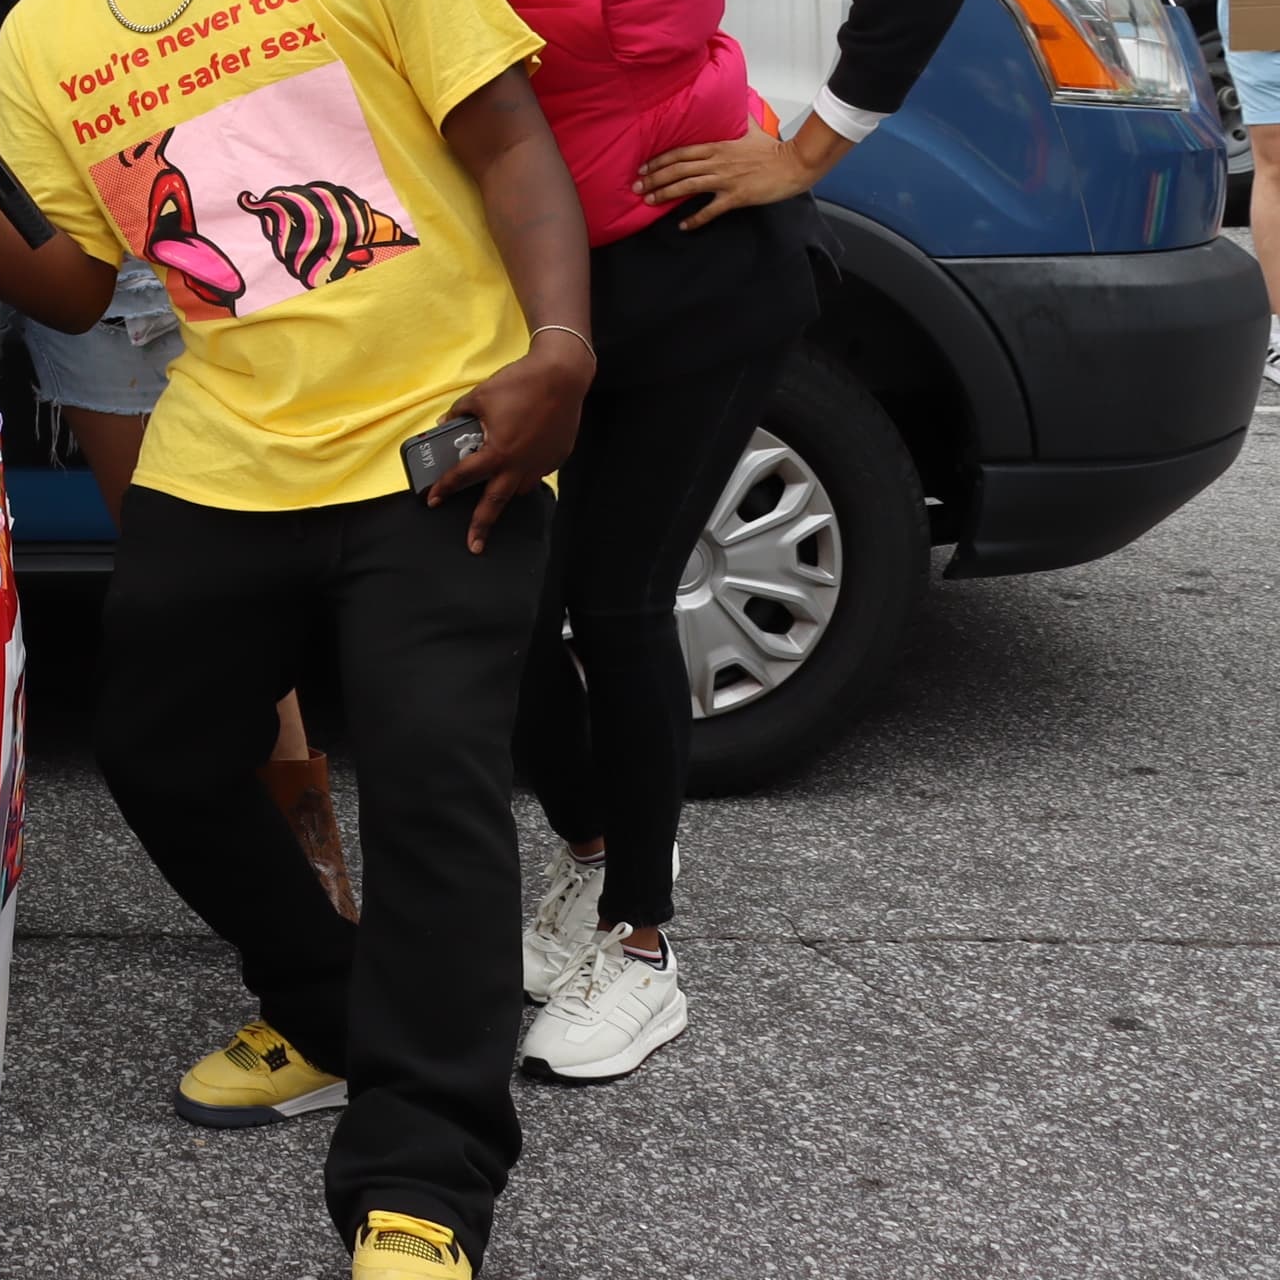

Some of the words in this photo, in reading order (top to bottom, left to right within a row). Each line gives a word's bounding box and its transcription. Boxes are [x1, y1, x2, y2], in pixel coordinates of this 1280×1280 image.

[59, 48, 150, 103] You're
[157, 4, 242, 58] never
[72, 104, 126, 146] hot
[127, 83, 170, 118] for
[177, 46, 252, 97] safer
[260, 22, 327, 60] sex.
